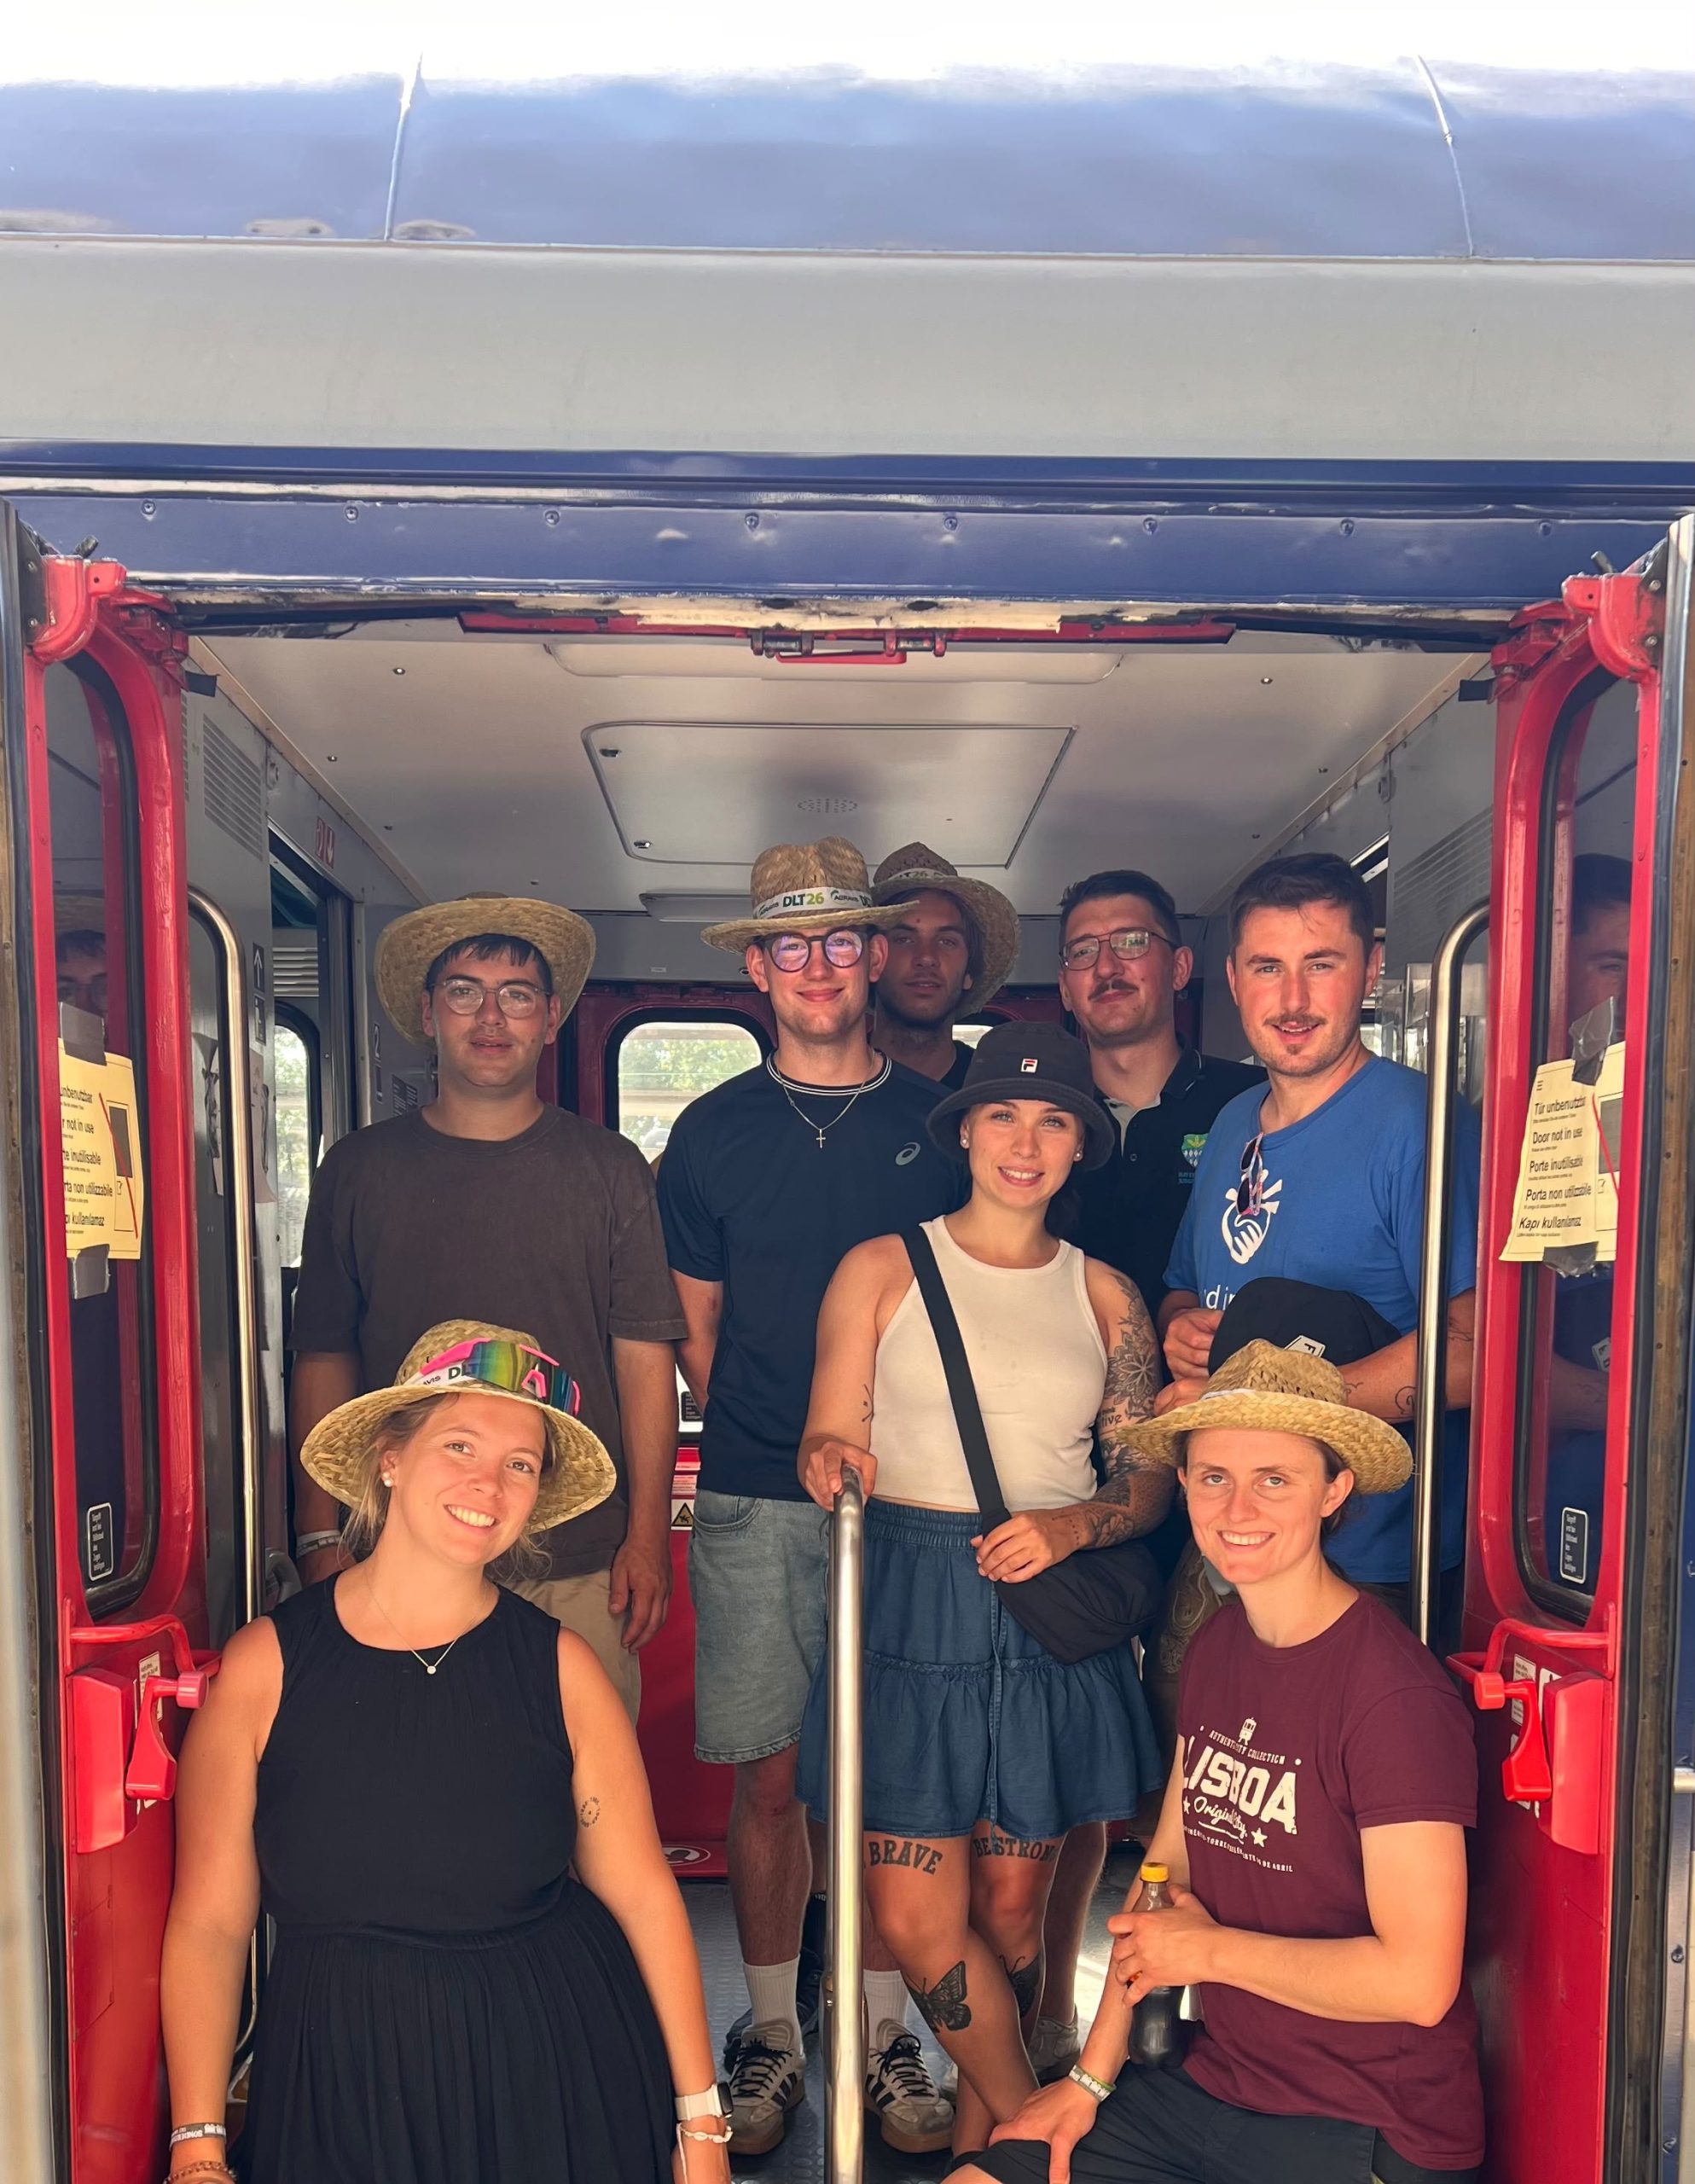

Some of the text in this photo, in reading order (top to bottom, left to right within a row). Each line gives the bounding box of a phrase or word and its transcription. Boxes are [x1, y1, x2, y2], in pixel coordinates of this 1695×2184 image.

[1533, 1131, 1550, 1144] Door
[1552, 1128, 1563, 1141] not
[1564, 1127, 1571, 1140] in
[1530, 1159, 1549, 1173] Porte
[1525, 1188, 1547, 1201] Porta
[1548, 1188, 1563, 1199] non
[868, 1839, 943, 1875] BRAVE
[972, 1837, 1059, 1862] BE STRON
